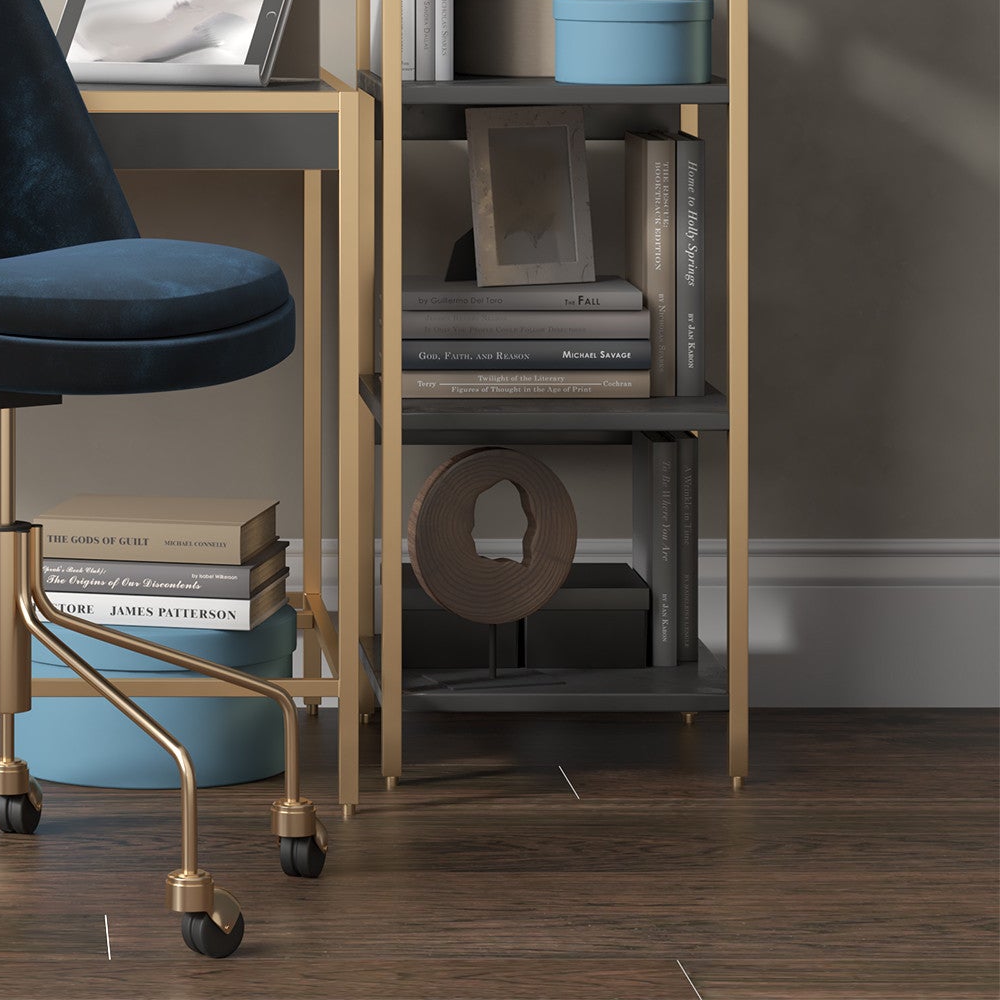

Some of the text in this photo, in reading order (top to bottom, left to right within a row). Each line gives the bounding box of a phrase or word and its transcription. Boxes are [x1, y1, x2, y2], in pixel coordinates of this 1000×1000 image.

[684, 160, 698, 287] Home to Holly Springs
[418, 296, 428, 304] by
[48, 534, 150, 546] THE GODS OF GUILT
[662, 524, 670, 541] You
[662, 544, 670, 562] Are
[46, 574, 202, 590] The Origins of Our Discontents
[110, 606, 153, 616] JAMES
[158, 608, 237, 620] PATTERSON
